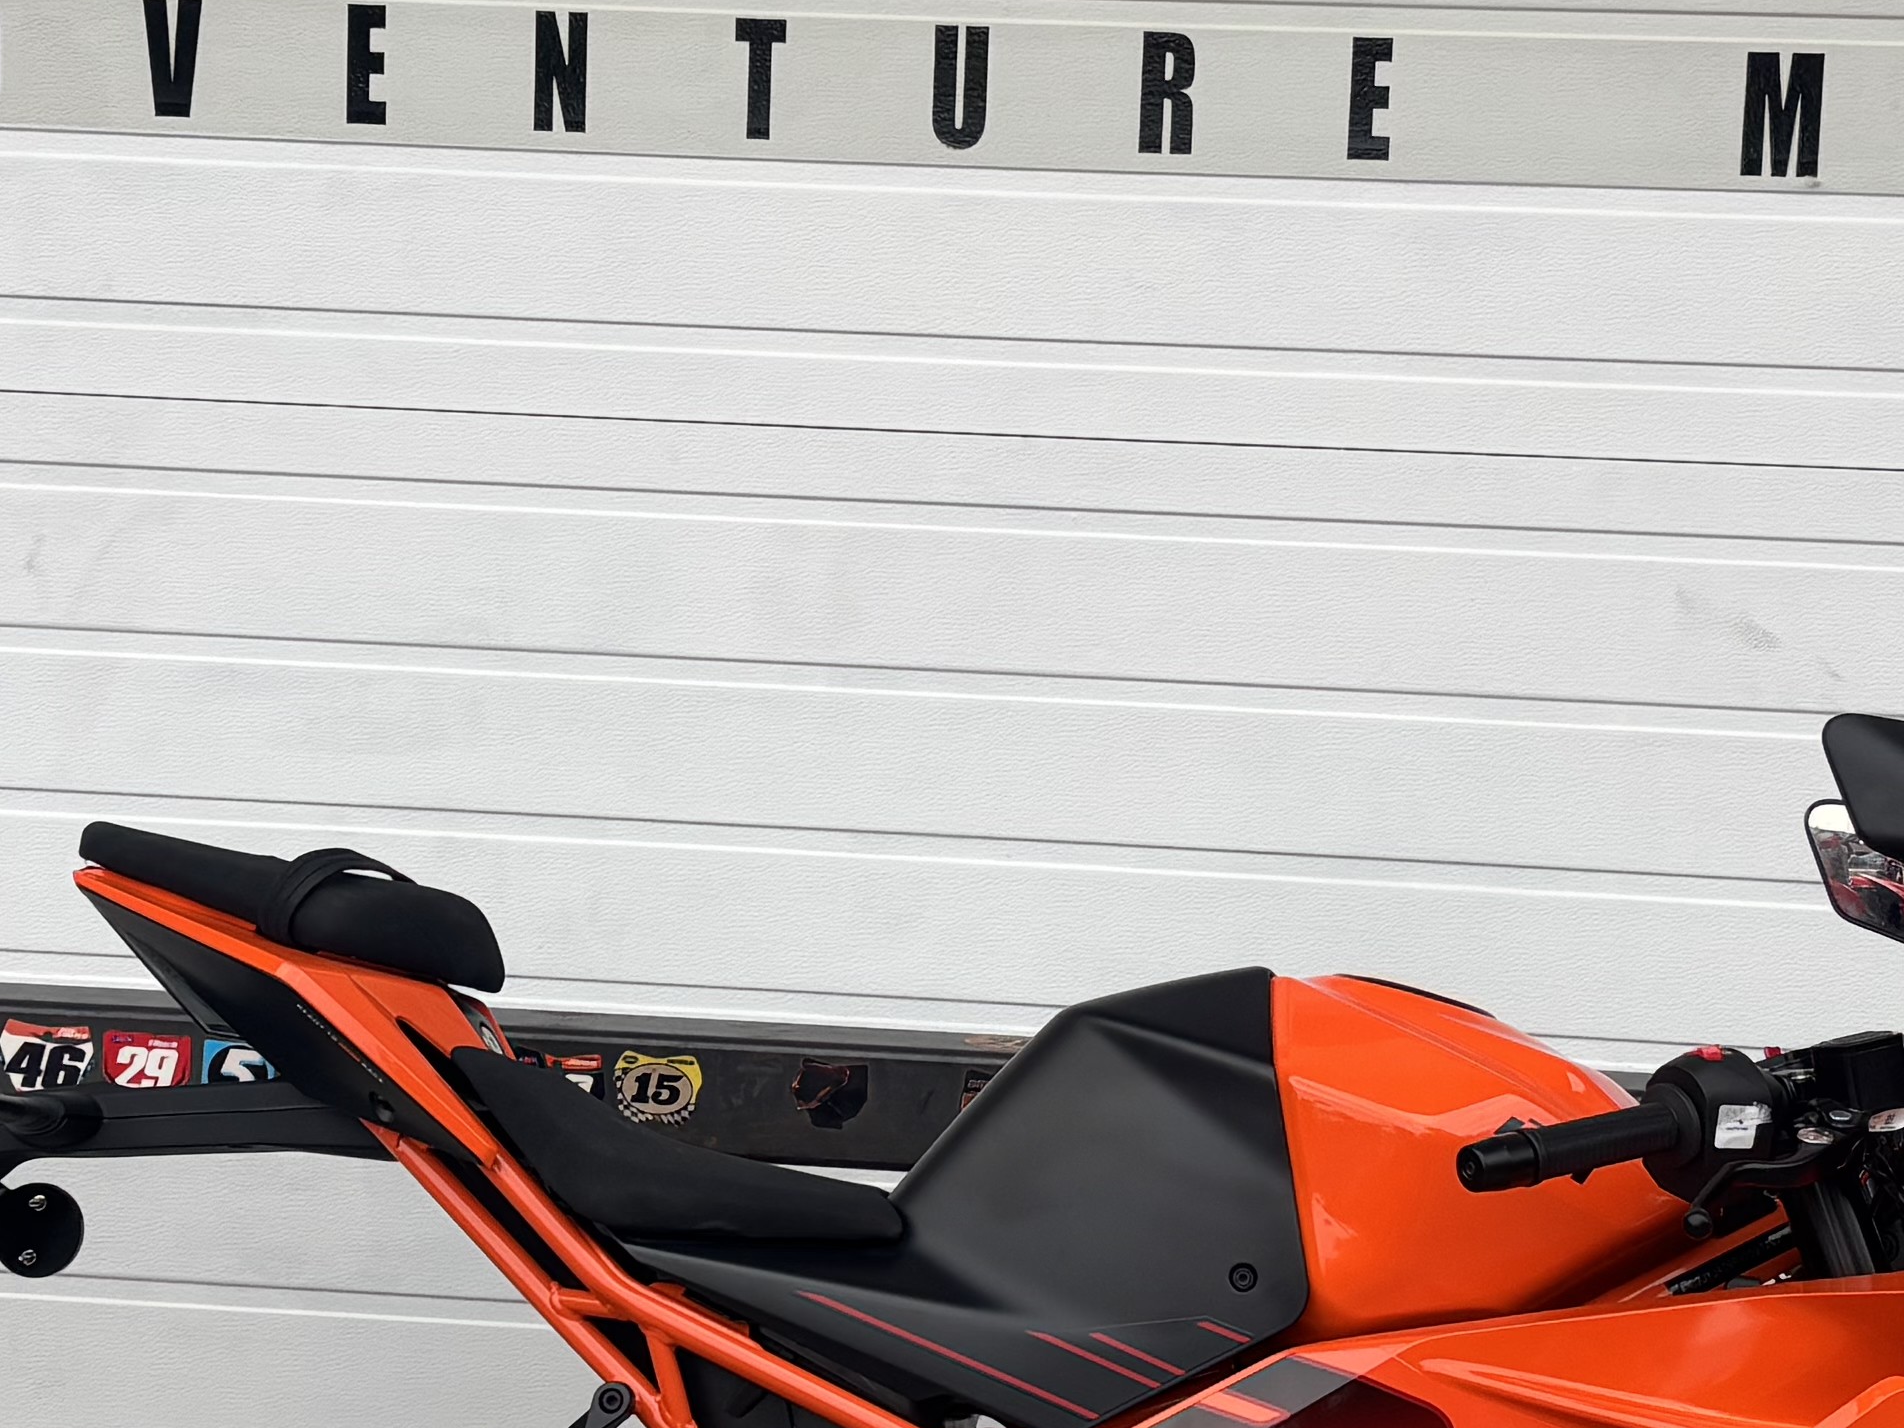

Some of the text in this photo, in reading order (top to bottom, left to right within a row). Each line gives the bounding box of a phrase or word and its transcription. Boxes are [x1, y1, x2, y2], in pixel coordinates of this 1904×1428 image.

[4, 1041, 86, 1088] 46
[114, 1045, 179, 1088] 29
[630, 1072, 684, 1105] 15
